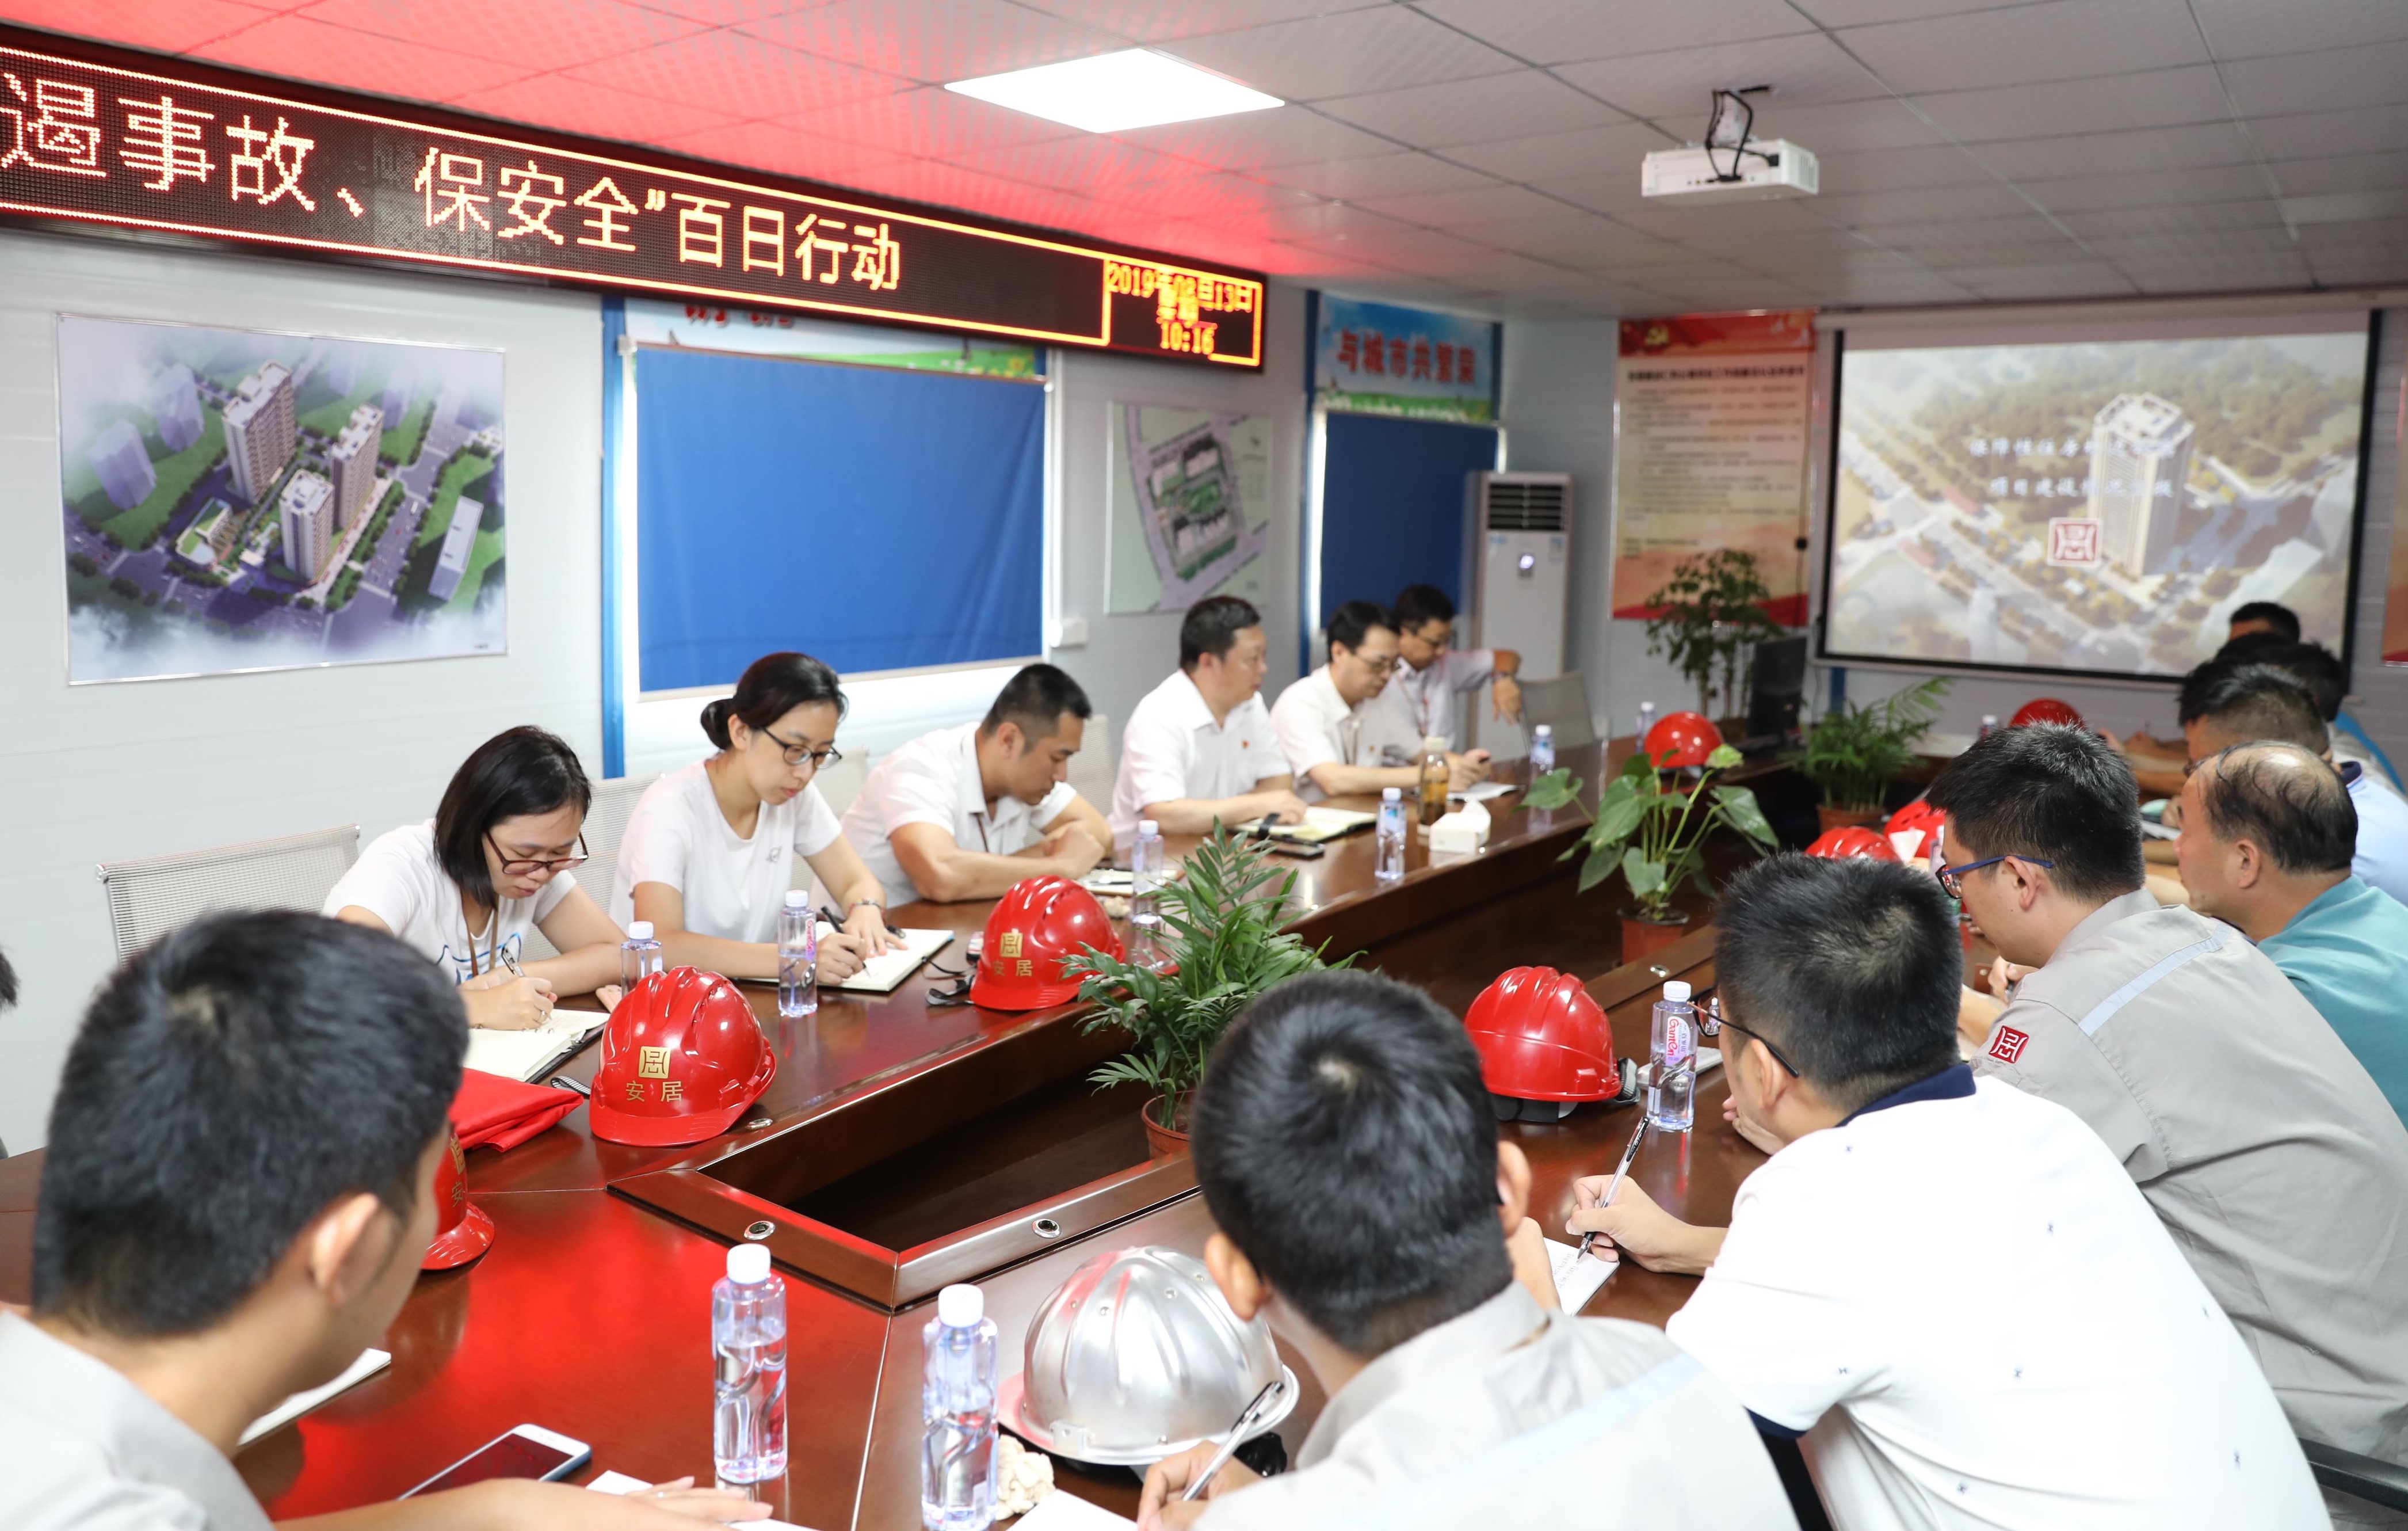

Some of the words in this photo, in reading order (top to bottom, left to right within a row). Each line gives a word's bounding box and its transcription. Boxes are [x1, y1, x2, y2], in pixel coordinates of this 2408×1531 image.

[1160, 321, 1215, 355] 10:16
[993, 959, 1033, 977] 安居
[625, 1080, 684, 1103] 安居
